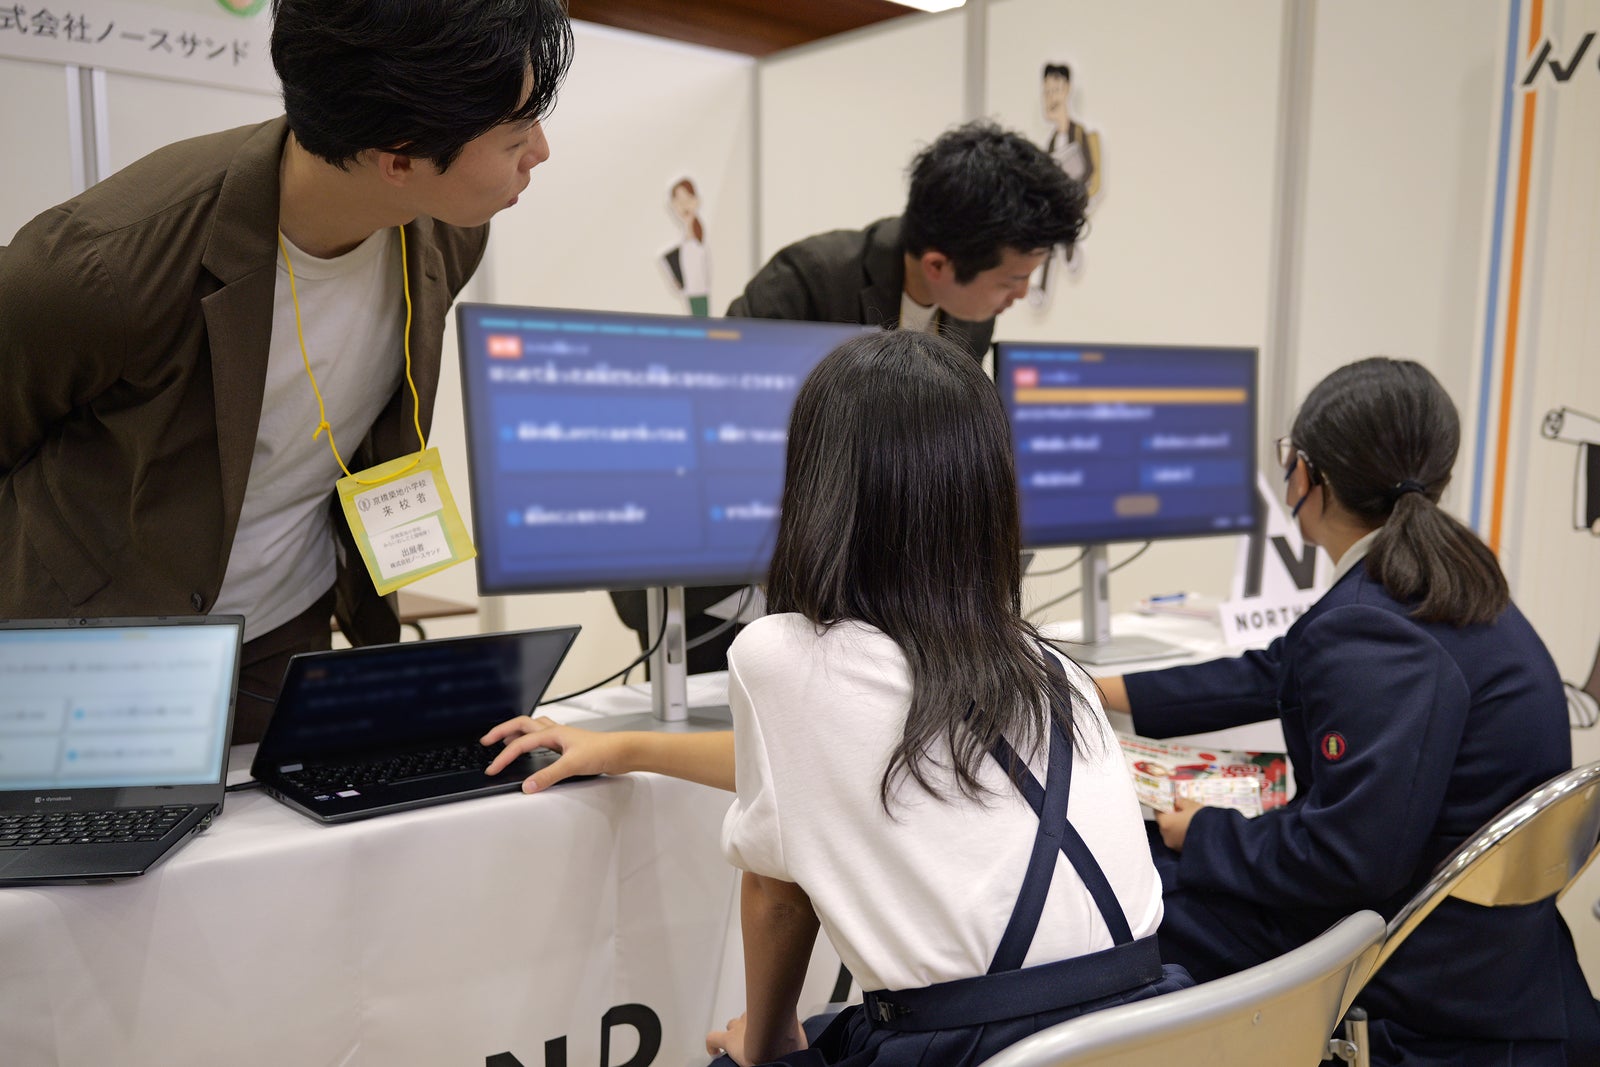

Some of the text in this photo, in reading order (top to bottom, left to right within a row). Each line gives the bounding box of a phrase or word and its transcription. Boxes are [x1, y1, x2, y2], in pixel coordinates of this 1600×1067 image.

[0, 4, 248, 66] 式会社ノースサンド
[1521, 32, 1600, 86] N
[372, 480, 427, 506] 京橋築地小学校
[1235, 604, 1314, 632] NORTH
